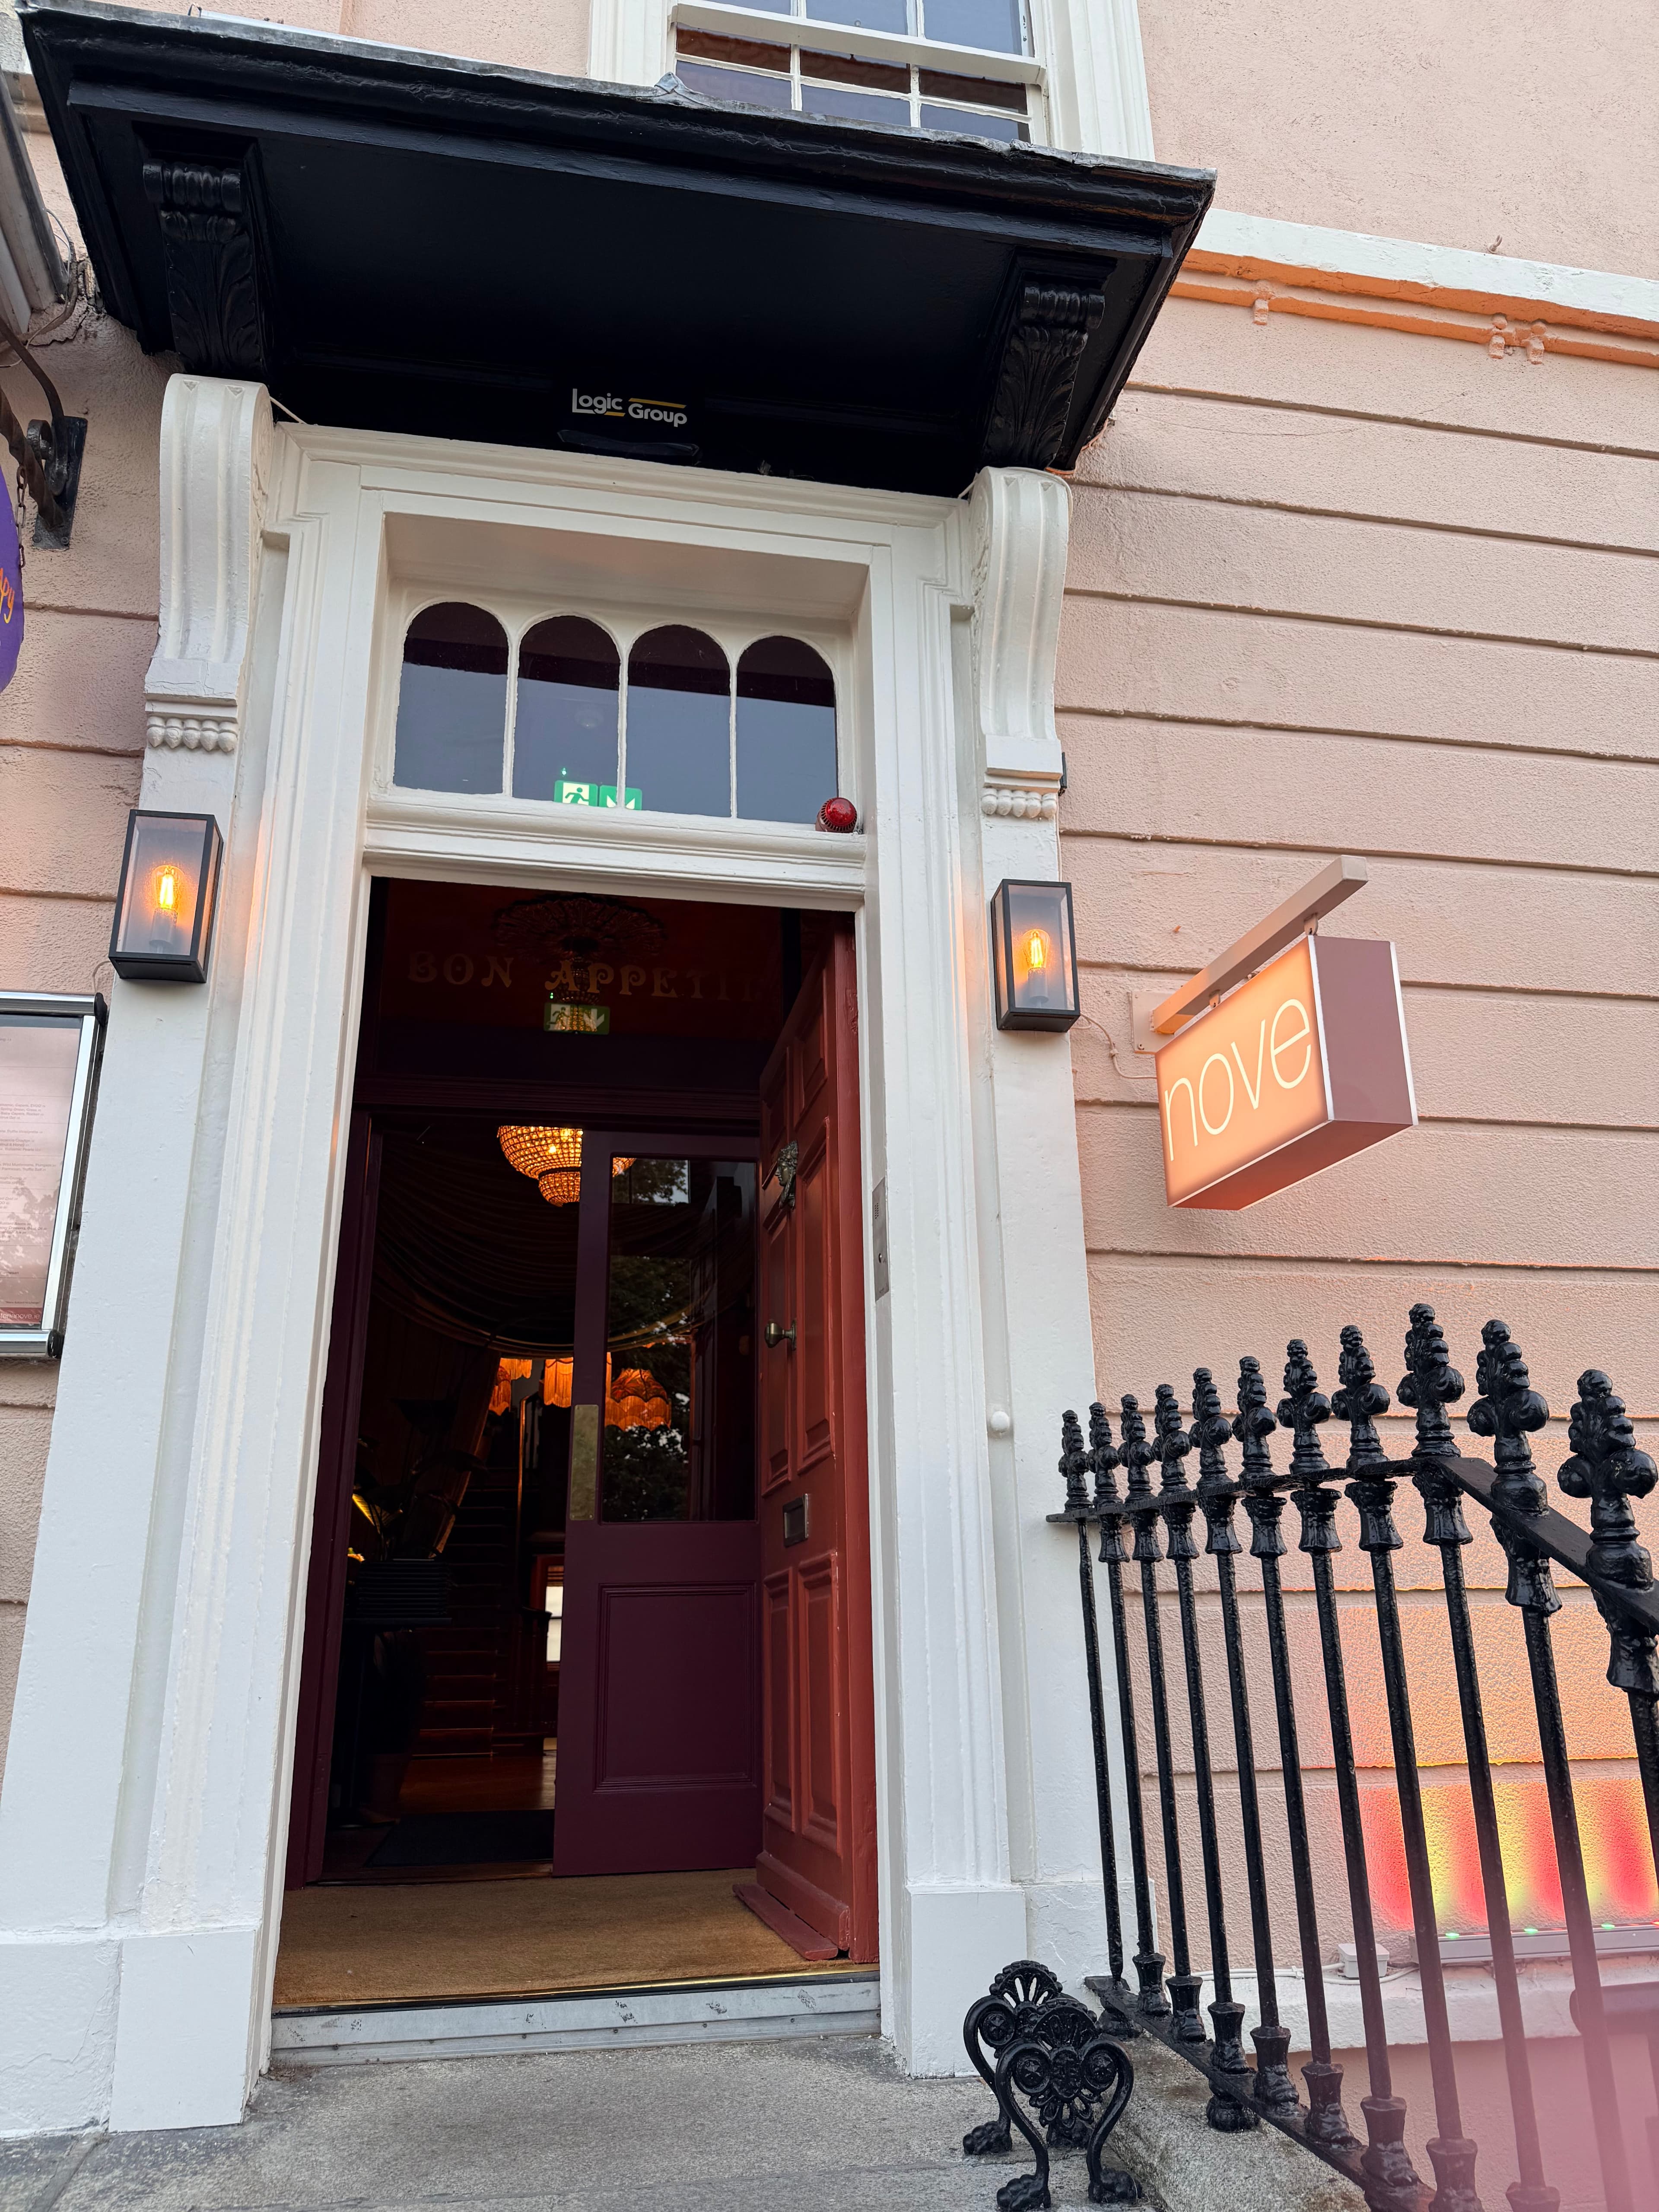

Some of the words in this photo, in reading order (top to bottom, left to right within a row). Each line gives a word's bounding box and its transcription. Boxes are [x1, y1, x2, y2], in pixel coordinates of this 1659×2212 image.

[572, 388, 623, 414] Logic
[628, 403, 687, 427] Group
[407, 951, 515, 988] BON
[1164, 998, 1312, 1161] nove
